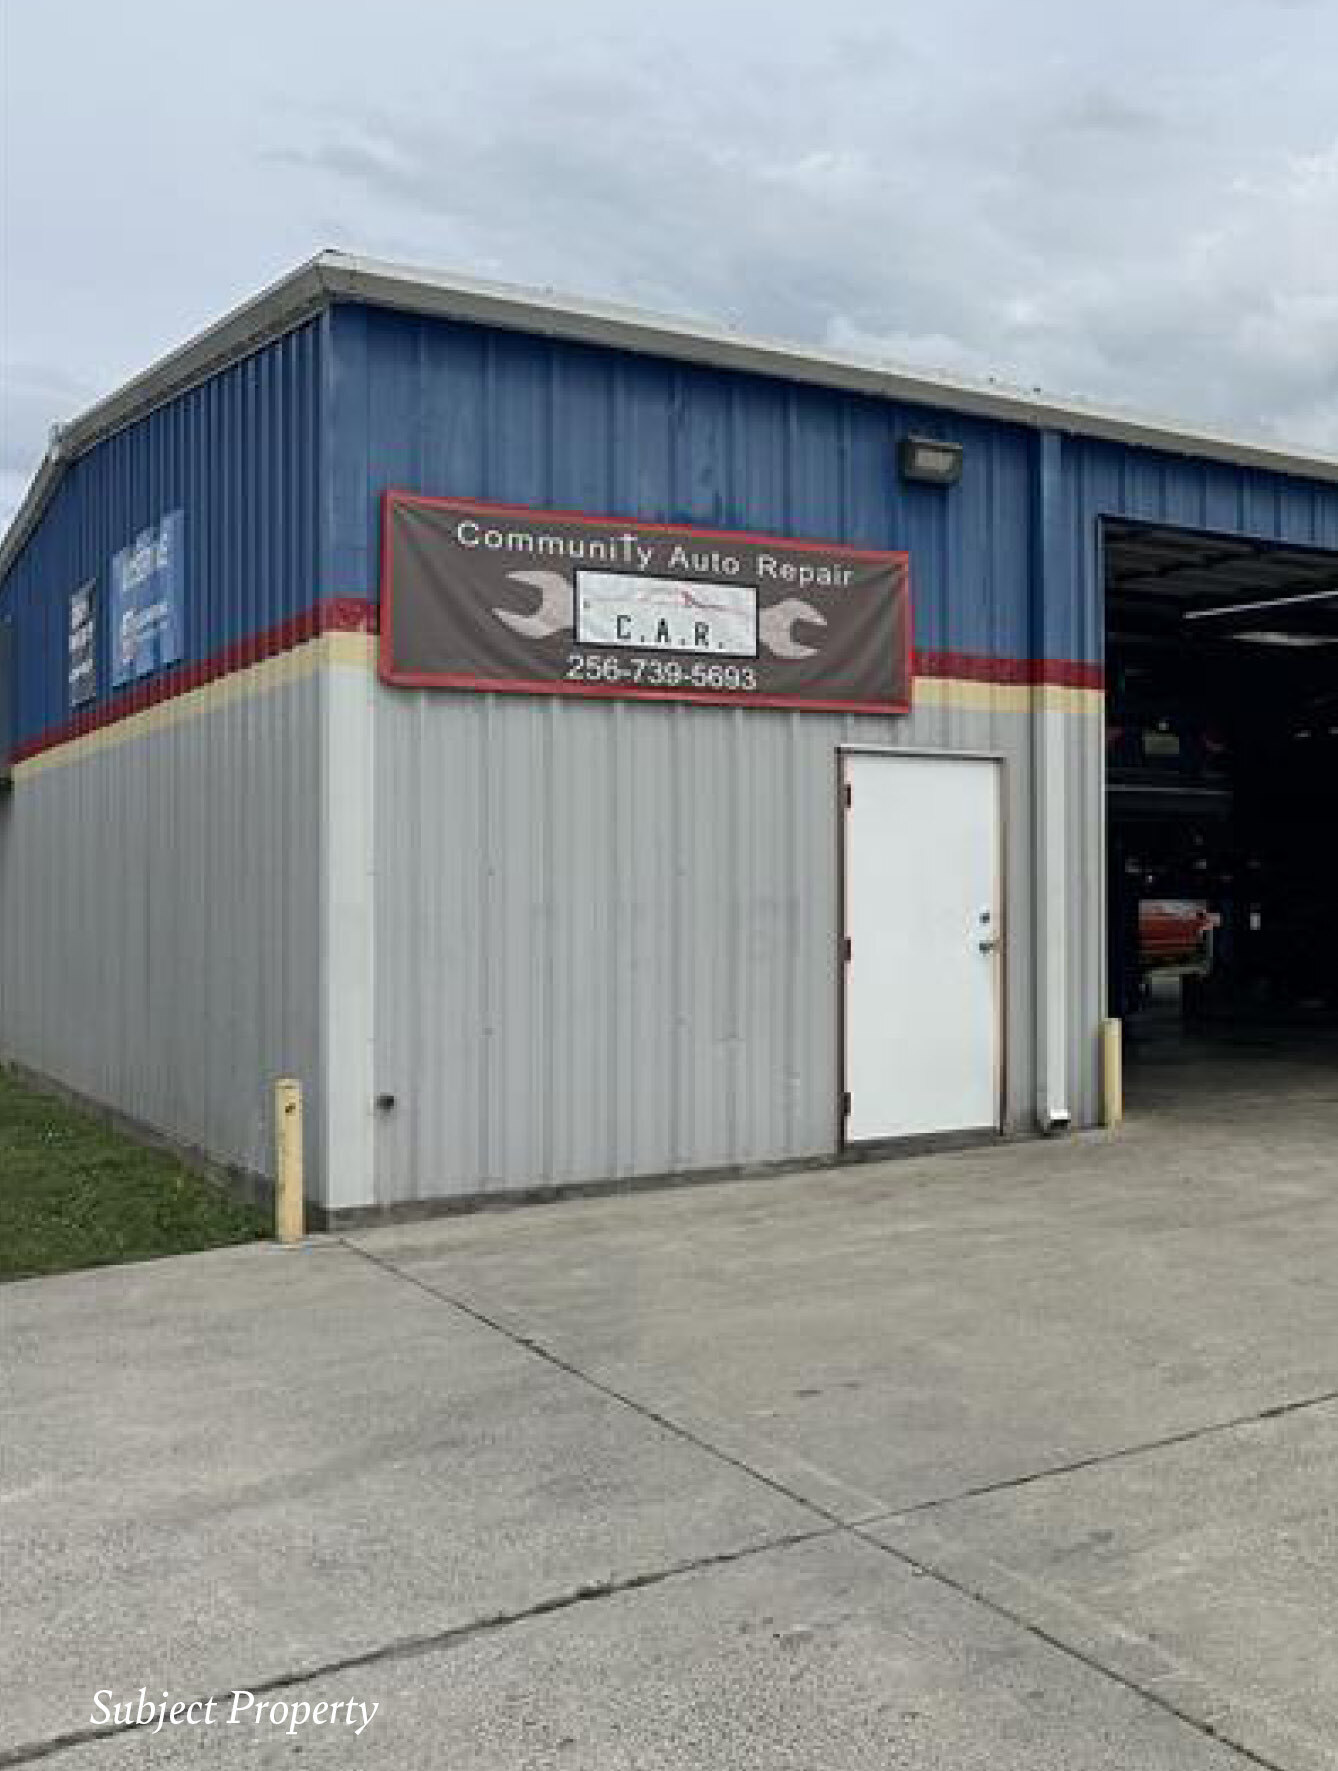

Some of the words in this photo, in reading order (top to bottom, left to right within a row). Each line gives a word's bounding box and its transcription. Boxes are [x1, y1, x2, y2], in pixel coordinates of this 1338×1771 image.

[668, 546, 739, 575] Auto
[758, 553, 855, 588] Repair
[565, 655, 757, 690] 256-739-5693
